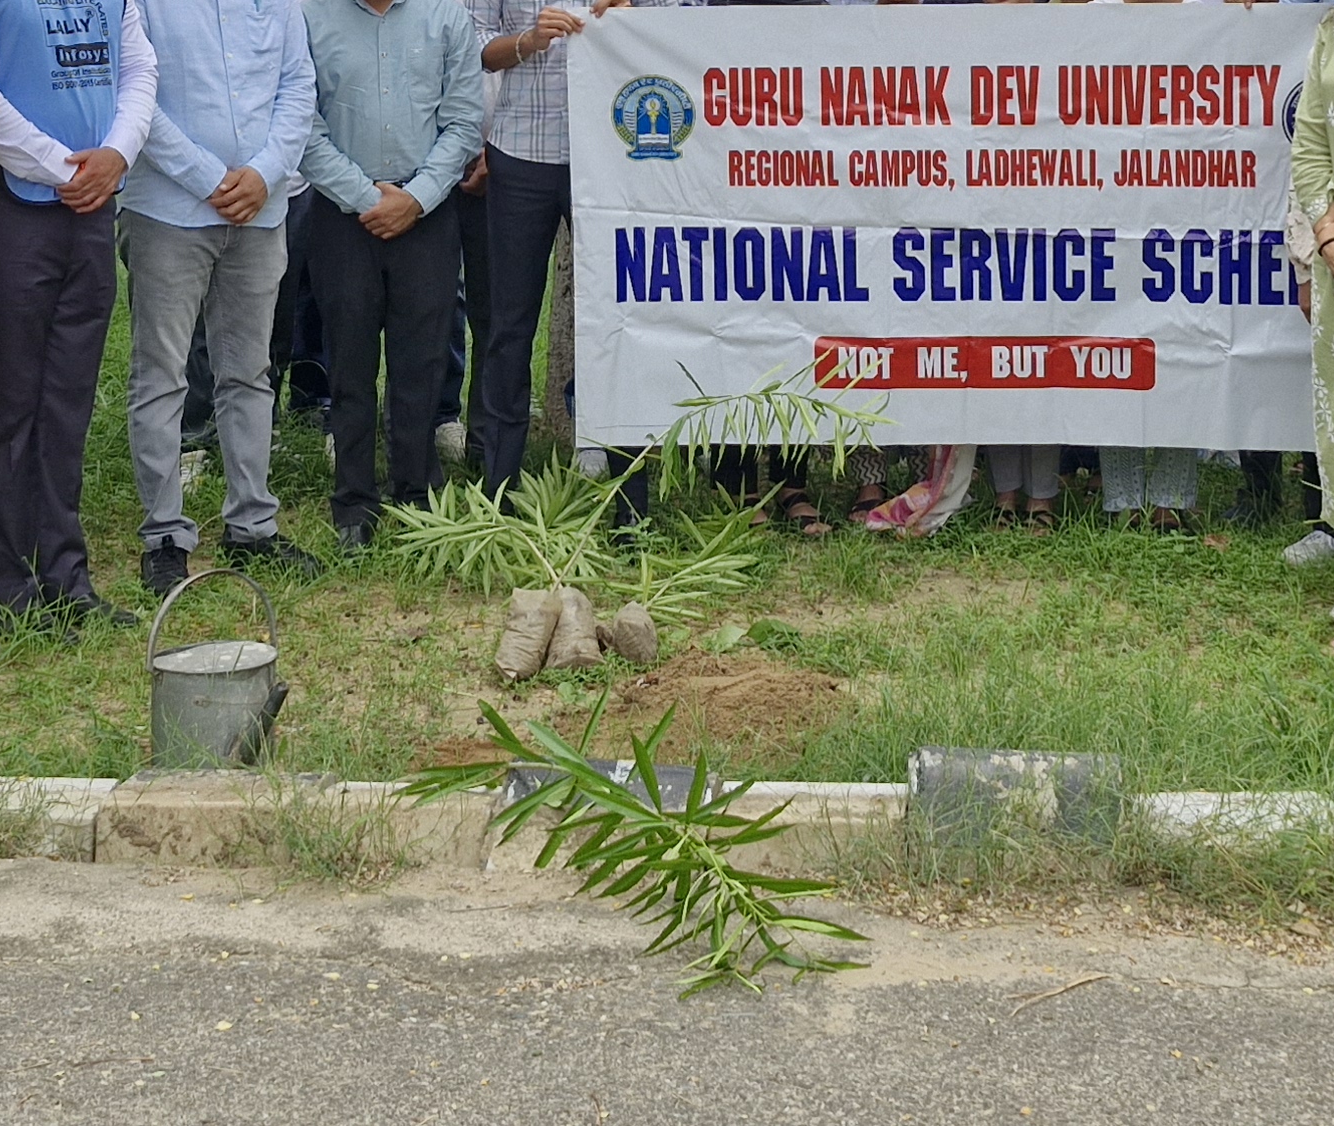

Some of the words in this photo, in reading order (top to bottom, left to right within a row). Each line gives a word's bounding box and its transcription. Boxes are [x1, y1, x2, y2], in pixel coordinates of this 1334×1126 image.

[703, 67, 804, 126] GURU
[820, 66, 951, 126] NANAK
[970, 65, 1039, 125] DEV
[1058, 65, 1281, 126] UNIVERSITY
[728, 150, 839, 187] REGIONAL
[849, 150, 955, 191] CAMPUS,
[966, 149, 1104, 191] LADHEWALI,
[1114, 149, 1256, 187] JALANDHAR
[615, 225, 869, 304] NATIONAL
[892, 226, 1117, 303] SERVICE
[1141, 229, 1299, 306] SCHE
[837, 346, 894, 379] NOT
[917, 346, 967, 383] ME,
[991, 346, 1048, 379] BUT
[1069, 346, 1132, 379] YOU
